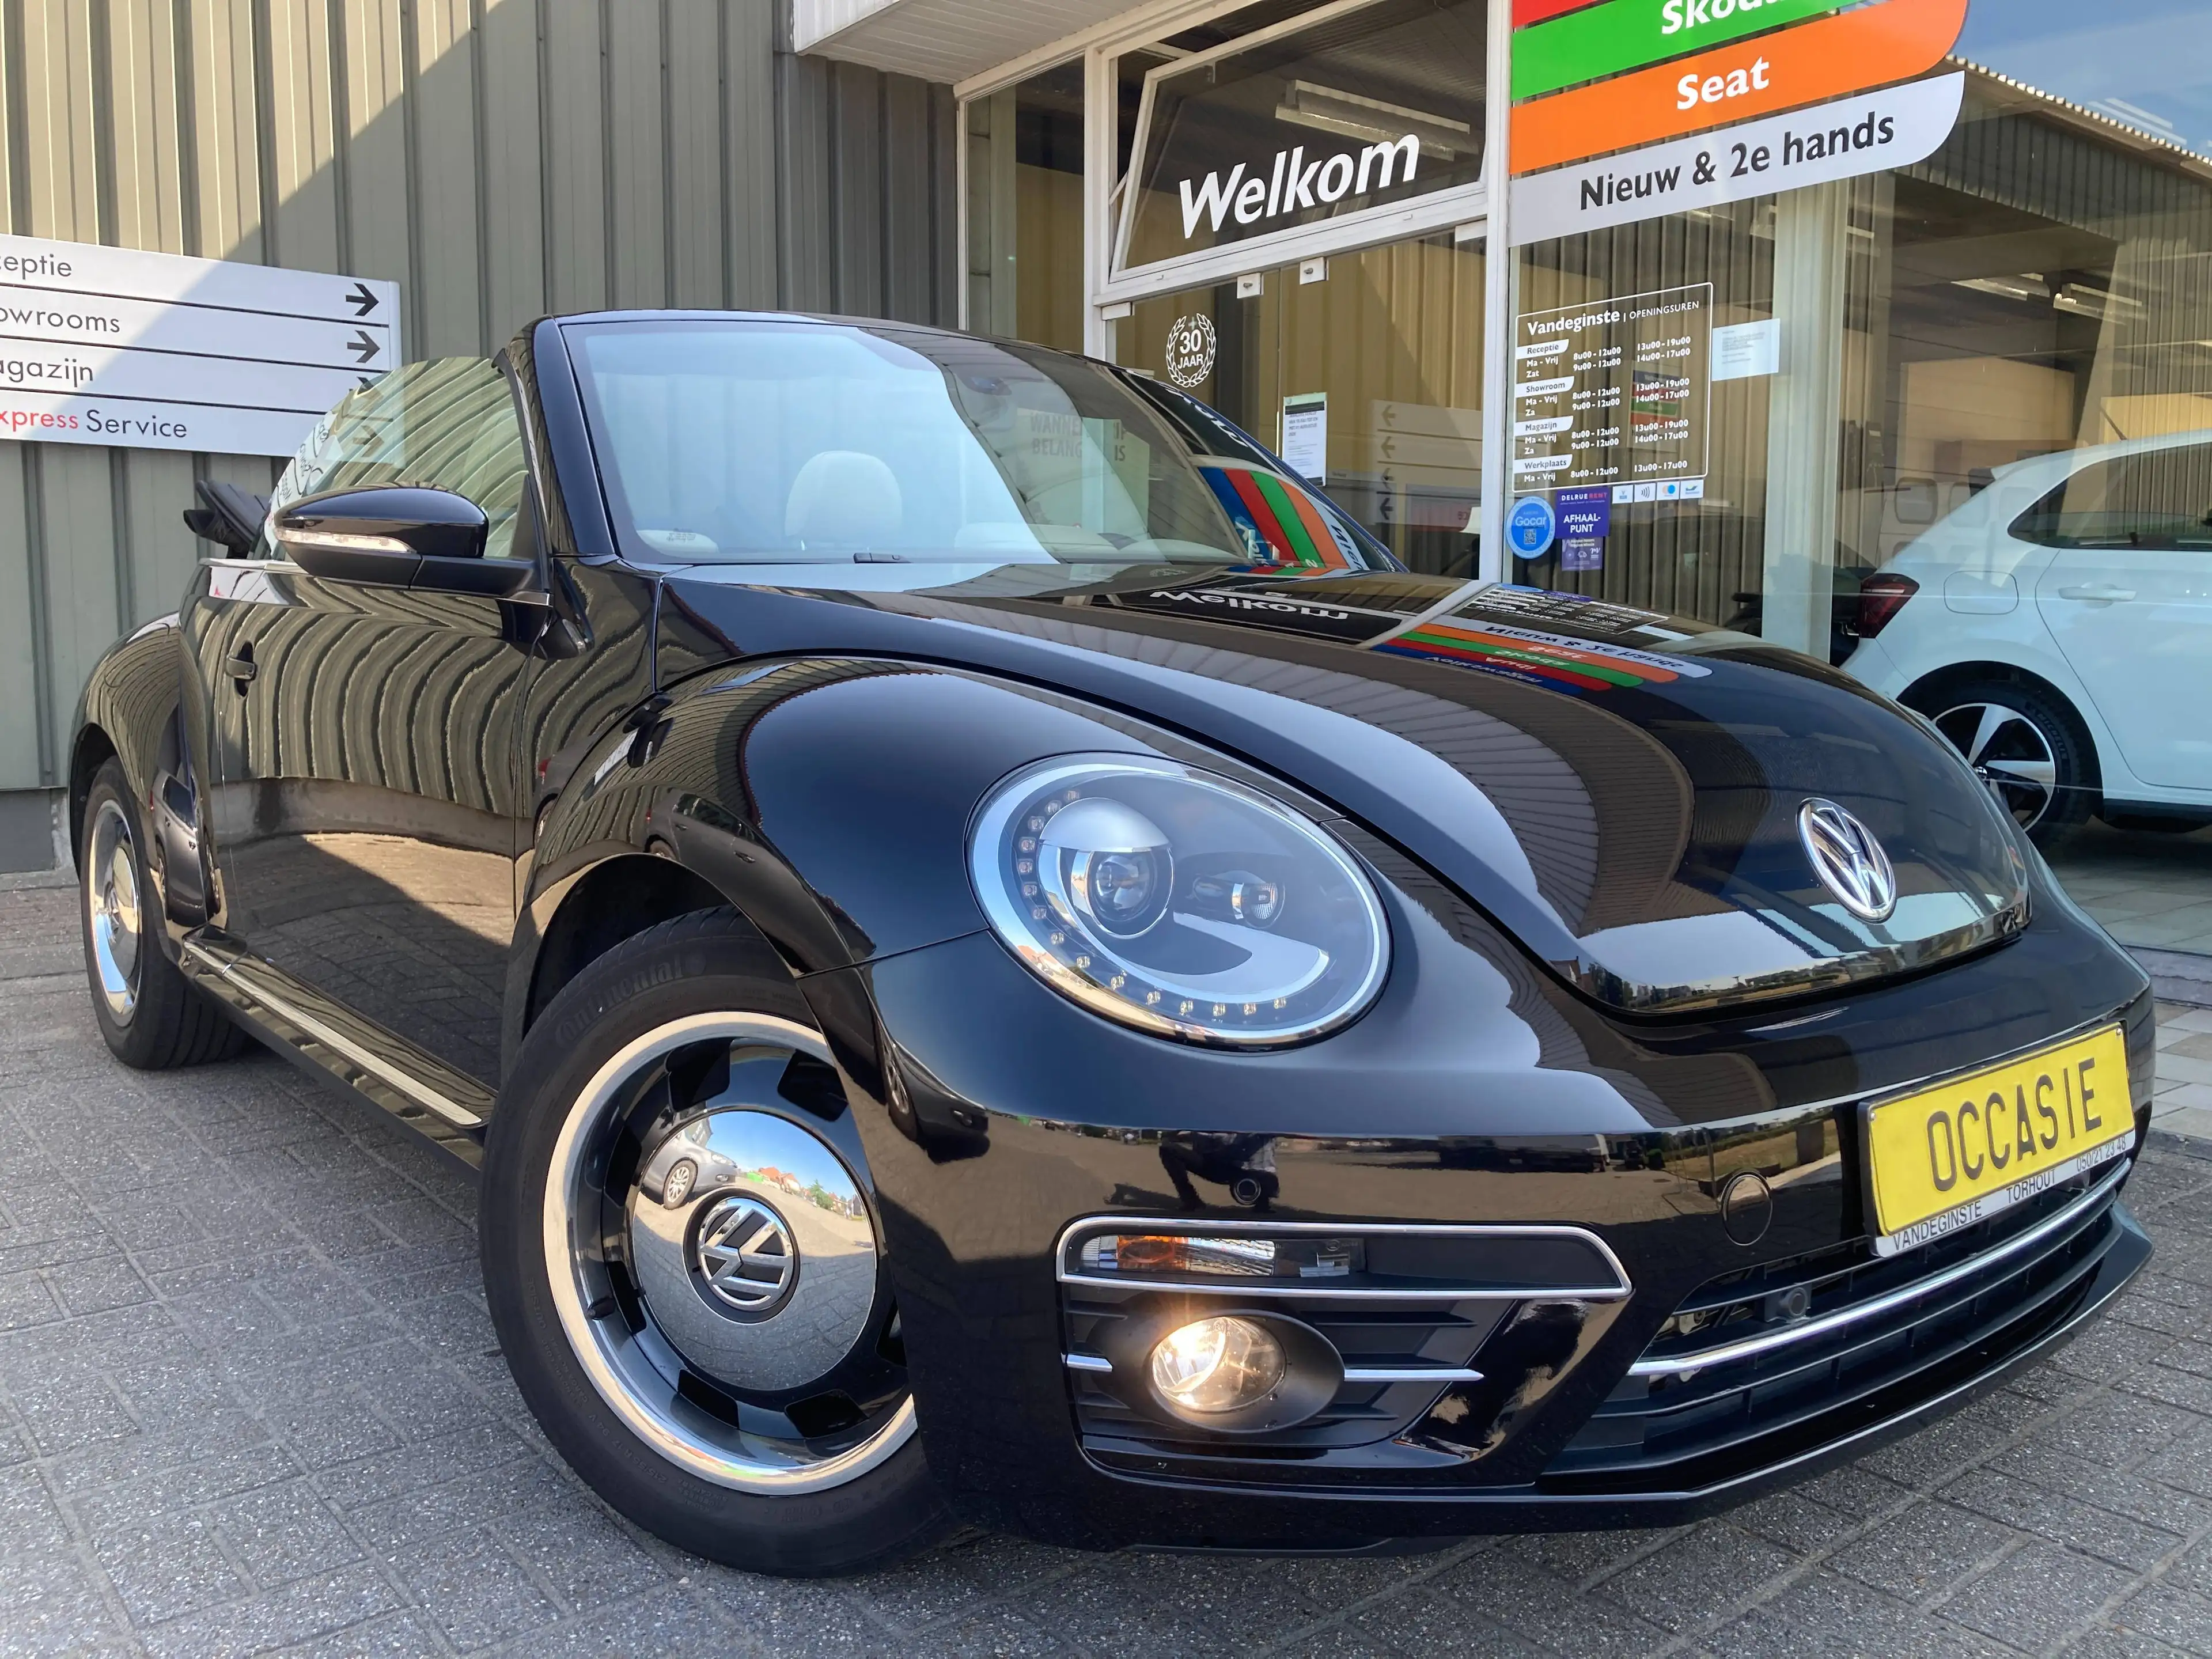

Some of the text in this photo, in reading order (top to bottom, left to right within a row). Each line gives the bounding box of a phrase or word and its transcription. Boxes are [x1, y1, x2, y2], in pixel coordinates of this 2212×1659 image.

[1661, 0, 1789, 34] Sko
[1677, 55, 1770, 111] Seat
[1580, 111, 1894, 211] Nieuw & 2e hands
[1179, 134, 1420, 239] Welkom
[0, 253, 72, 280] eptie
[1527, 309, 1620, 335] Vandeginste
[1629, 300, 1699, 320] OPENINGSUREN
[1180, 330, 1202, 355] 30
[1527, 343, 1559, 355] Receptie
[1545, 356, 1559, 365] Vrij
[1573, 351, 1592, 360] 8u00
[1599, 346, 1622, 357] 12u00
[1637, 340, 1661, 351] 13u00
[1666, 336, 1691, 347] 19u00
[1177, 353, 1204, 370] JAAR
[1573, 362, 1592, 371] 9u00
[1599, 358, 1621, 368] 12u00
[1637, 352, 1660, 362] 14u00
[1666, 348, 1691, 358] 17u00
[0, 358, 93, 388] gazijn
[1527, 381, 1565, 393] Showroom
[1544, 395, 1558, 404] Vrij
[1573, 391, 1591, 399] 8u00
[1598, 387, 1620, 396] 12u00
[1636, 381, 1660, 391] 13u00
[1666, 377, 1690, 388] 19u00
[1572, 402, 1590, 411] 9u00
[1597, 397, 1620, 408] 12u00
[1636, 393, 1659, 403] 14u00
[1665, 389, 1690, 399] 17u00
[86, 409, 187, 438] Service
[1525, 422, 1557, 431] Magazijn
[1544, 434, 1557, 443] Vrij
[1571, 430, 1590, 439] 8u00
[1597, 426, 1619, 437] 12u00
[1635, 423, 1658, 432] 13u00
[1665, 419, 1689, 429] 19u00
[1571, 442, 1590, 450] 9u00
[1597, 438, 1619, 448] 12u00
[1635, 434, 1658, 443] 14u00
[1664, 430, 1688, 441] 17u00
[1525, 460, 1567, 469] Werkplaats
[1543, 472, 1556, 482] Vrij
[1570, 469, 1589, 478] 8u00
[1596, 467, 1619, 476] 12u00
[1634, 463, 1658, 472] 13u00
[1664, 460, 1688, 471] 17u00
[1561, 493, 1588, 502] DELRUE
[1515, 516, 1547, 527] Gocar
[1563, 512, 1601, 524] AFHAAL-
[1570, 523, 1594, 534] PUNT
[555, 953, 684, 1048] Continental
[1926, 1057, 2102, 1191] OCCASIE
[1893, 1201, 1982, 1251] VANDEGINSTE
[2006, 1168, 2056, 1204] TORHOUT
